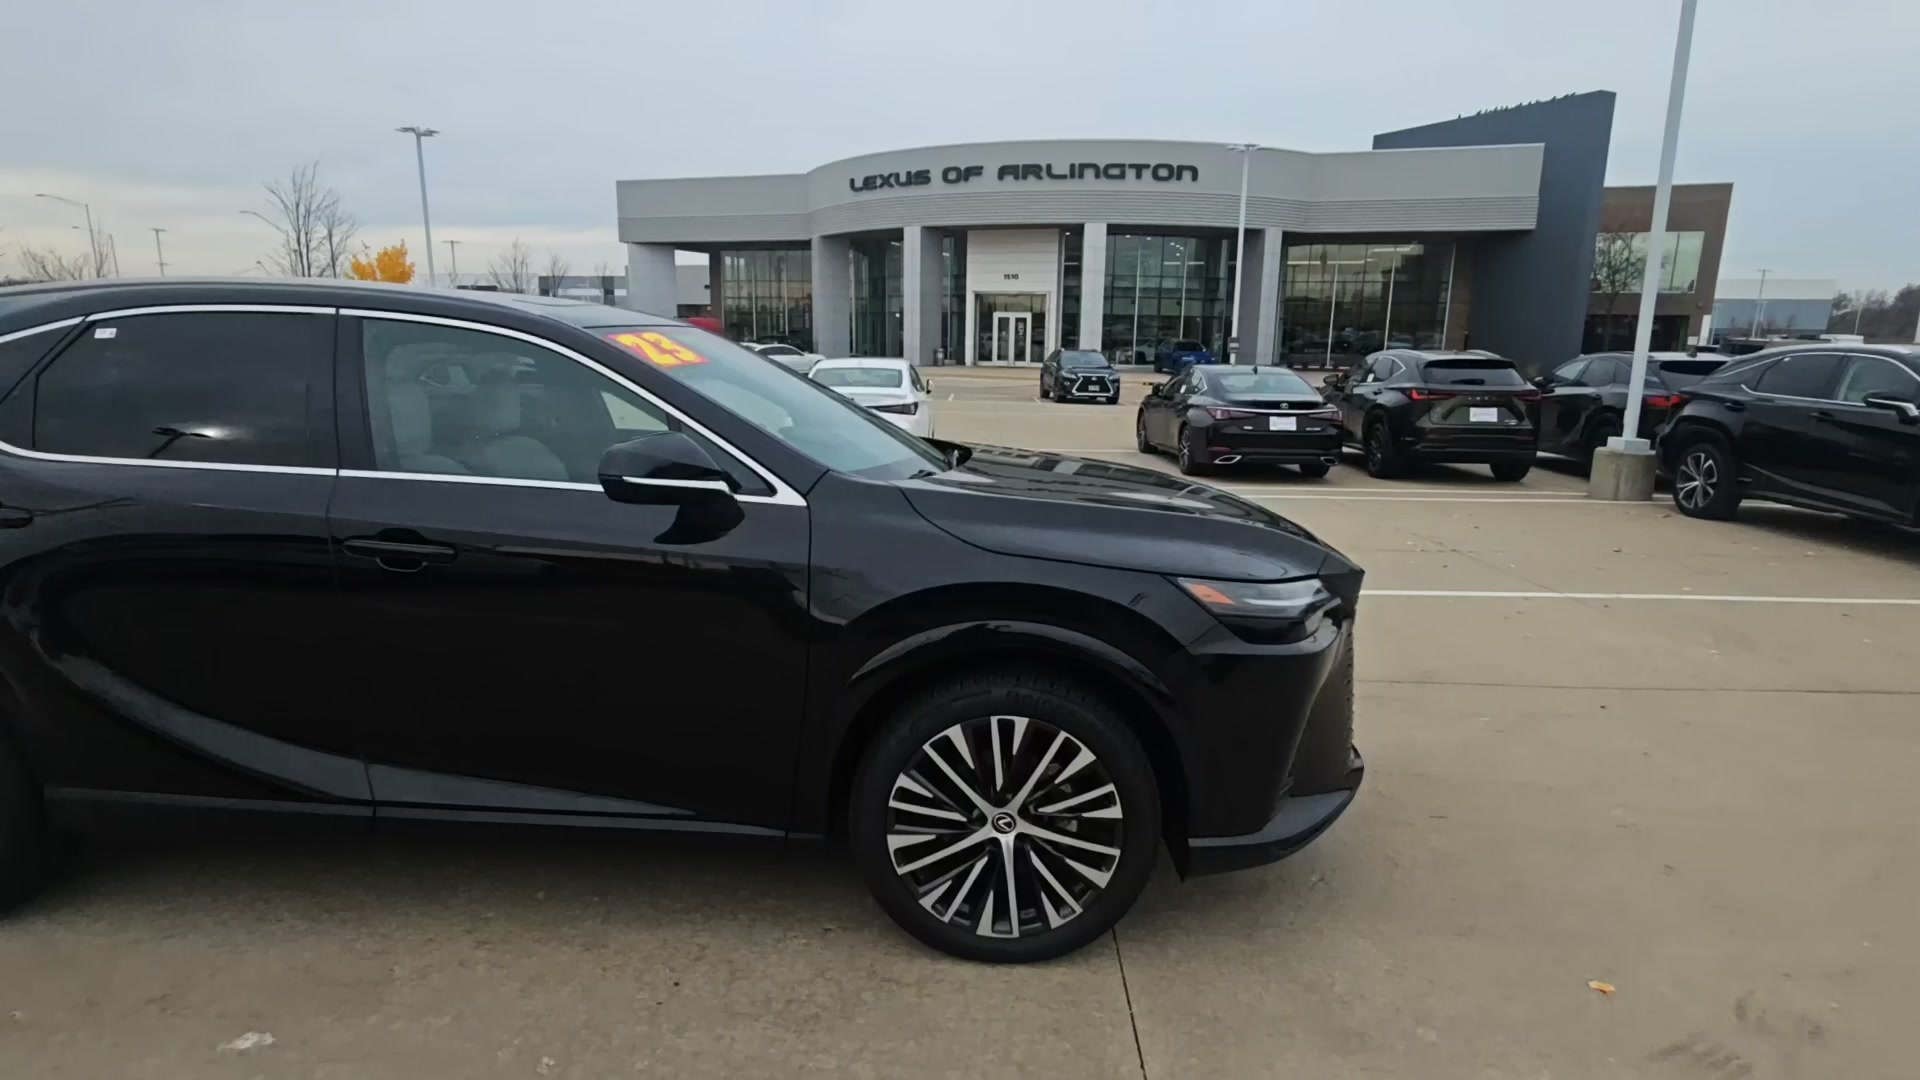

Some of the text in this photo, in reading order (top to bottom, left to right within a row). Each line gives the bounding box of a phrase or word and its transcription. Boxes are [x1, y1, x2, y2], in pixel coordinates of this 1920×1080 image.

[850, 163, 1199, 192] LEXUS OF ARLINGTON
[614, 331, 700, 367] 23
